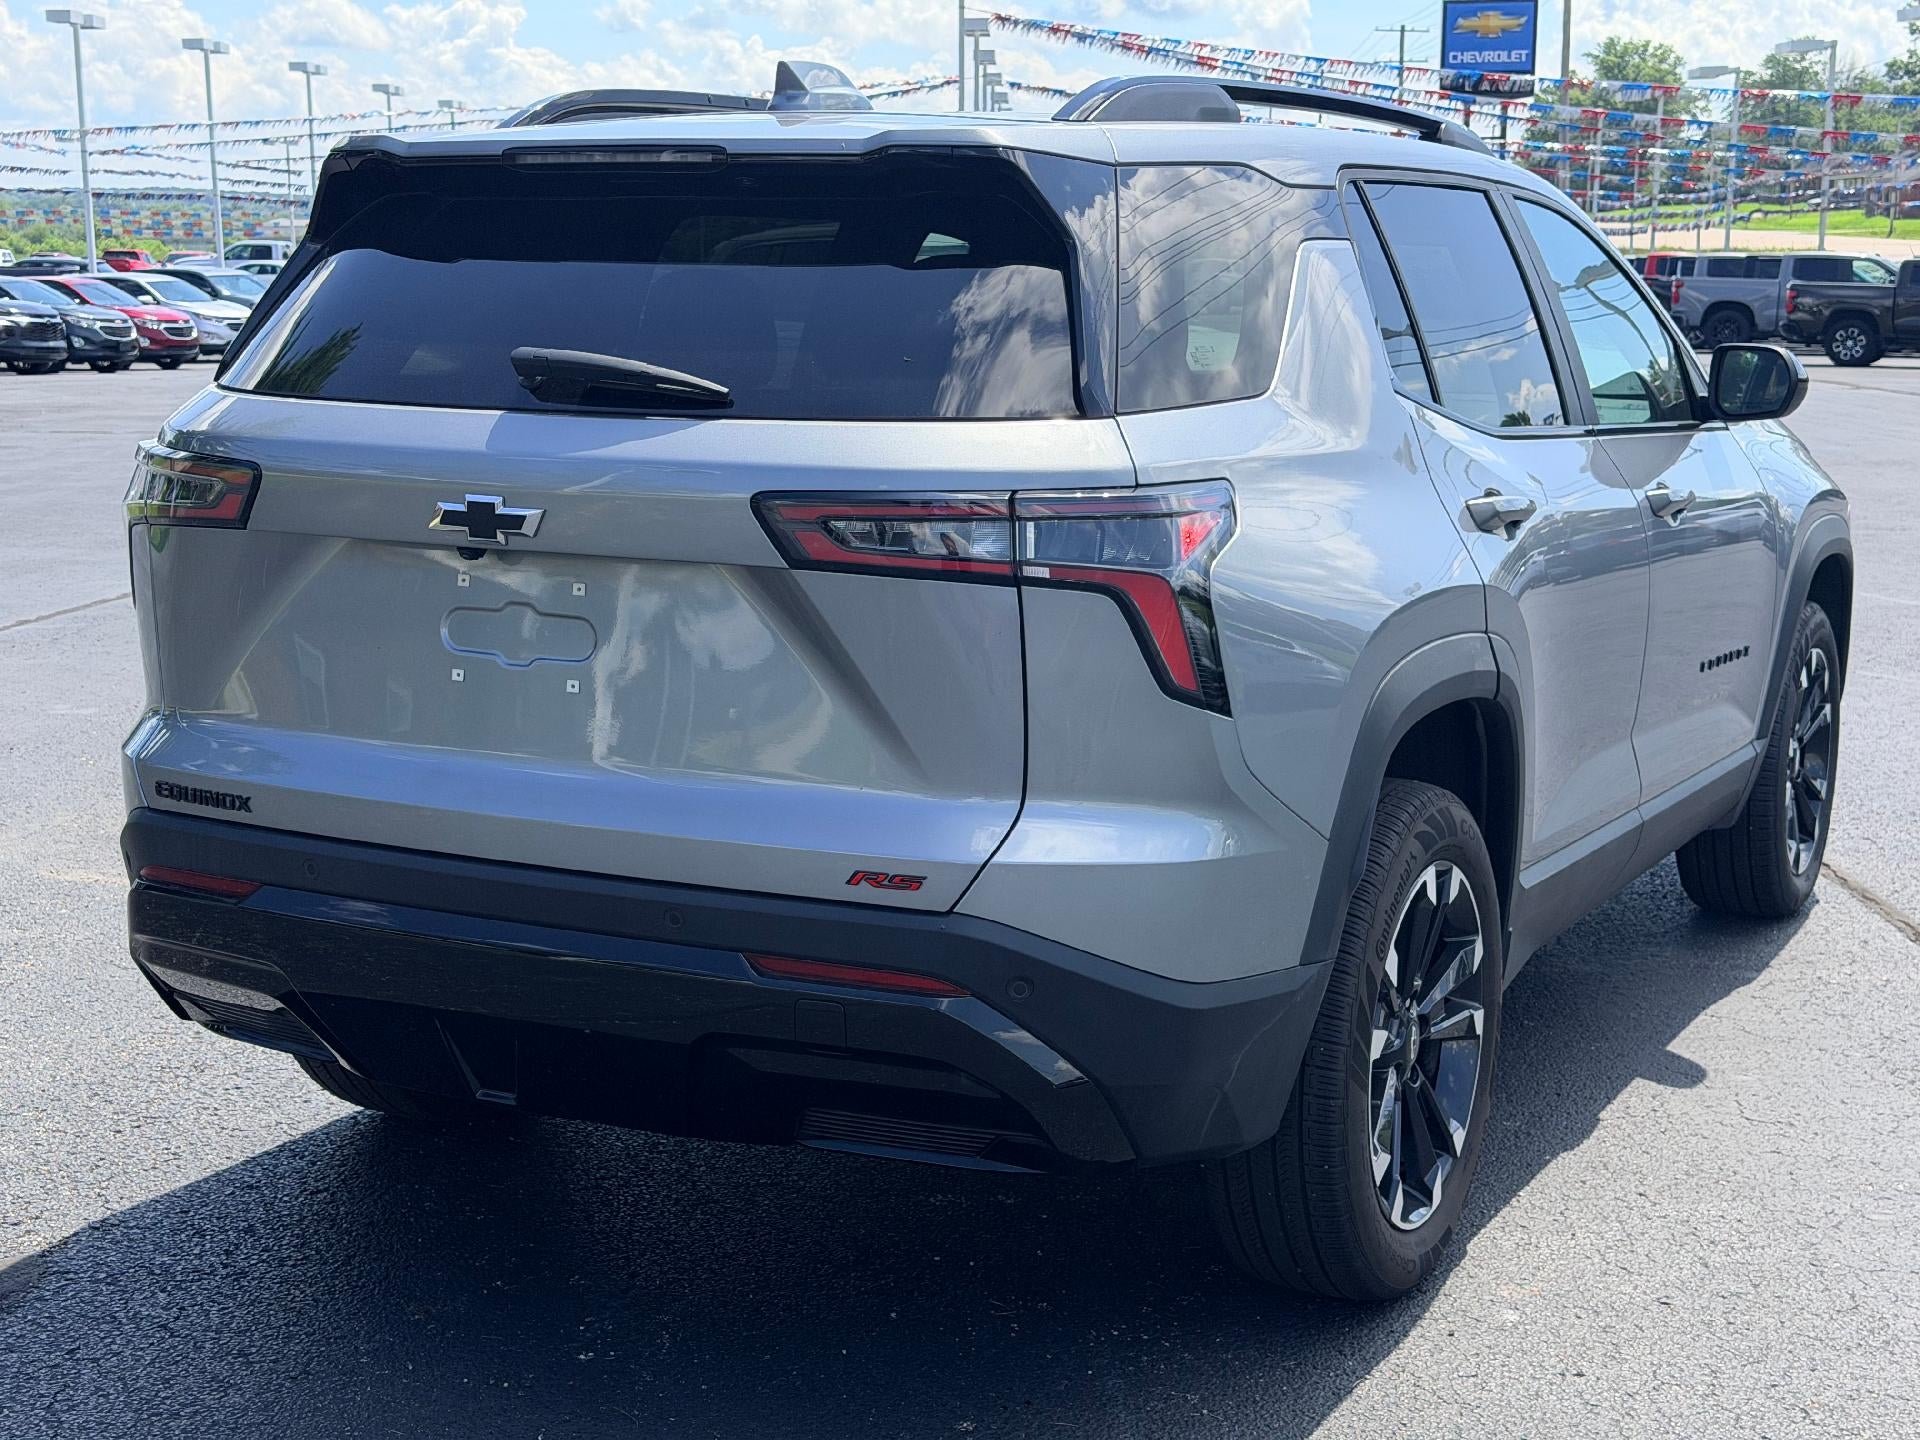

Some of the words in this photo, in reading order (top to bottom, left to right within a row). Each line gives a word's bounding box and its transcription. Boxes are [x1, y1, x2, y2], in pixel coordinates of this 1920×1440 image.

[1449, 50, 1529, 64] CHEVROLET
[154, 779, 253, 813] EQUINOX
[845, 870, 928, 891] RS
